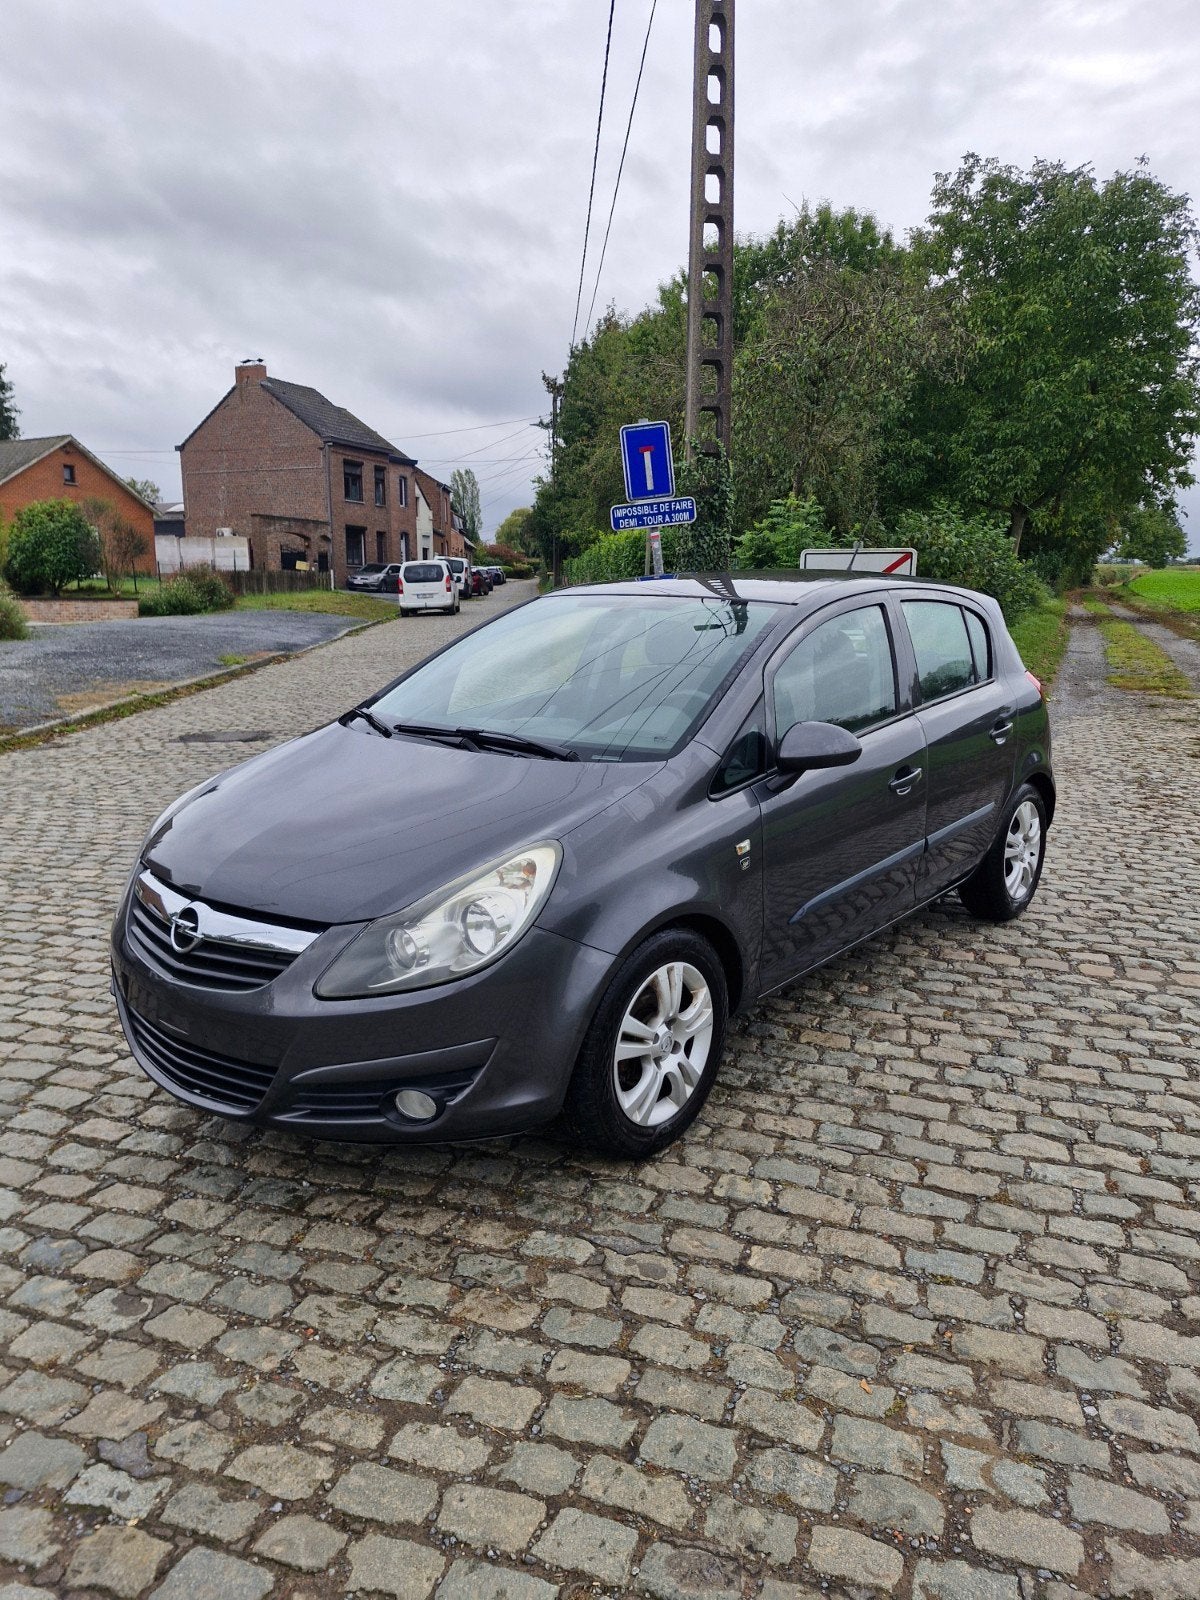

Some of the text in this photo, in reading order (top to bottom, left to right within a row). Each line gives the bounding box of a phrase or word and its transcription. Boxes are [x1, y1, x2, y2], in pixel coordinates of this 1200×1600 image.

[614, 500, 692, 518] IMPOSSIBLE DE FAIRE
[619, 518, 637, 528] DEMI
[643, 515, 663, 525] TOUR
[665, 514, 671, 522] A
[672, 512, 689, 522] 300M
